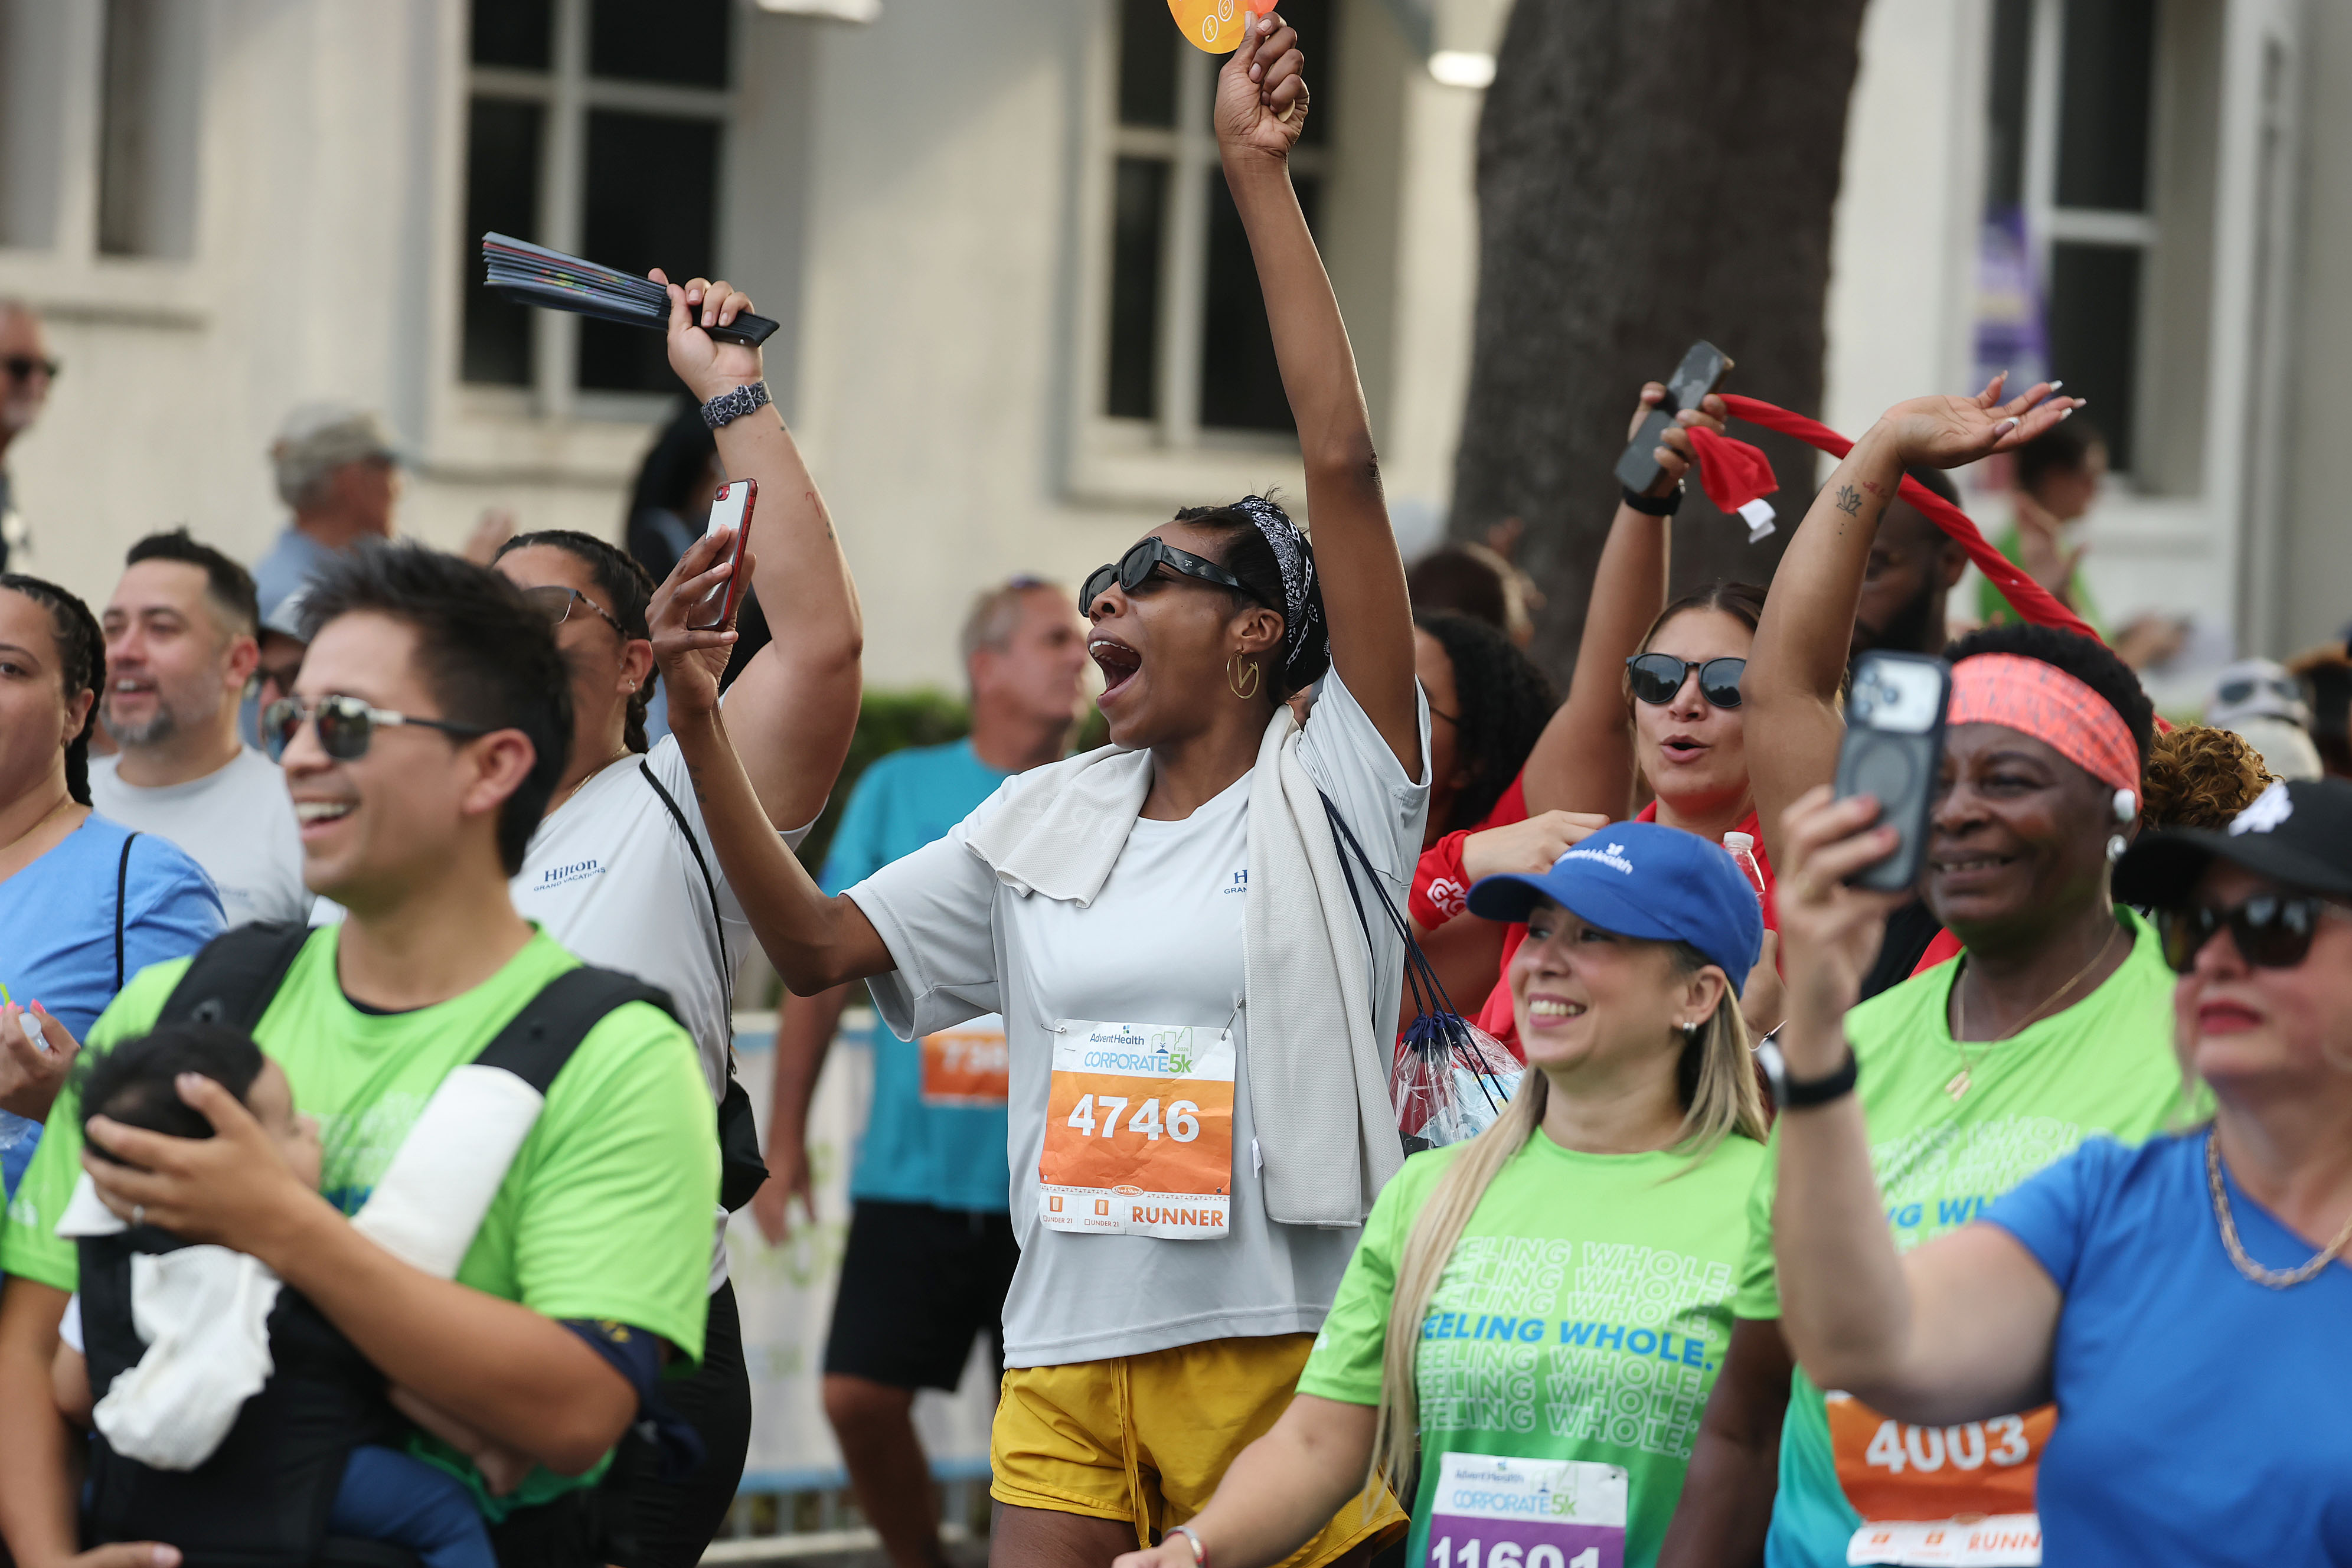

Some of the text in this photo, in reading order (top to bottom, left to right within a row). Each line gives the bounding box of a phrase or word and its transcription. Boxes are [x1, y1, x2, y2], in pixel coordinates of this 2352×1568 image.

[534, 867, 606, 891] GRAND VACATIONS
[544, 859, 597, 882] Hilton
[1224, 886, 1247, 894] GRAN
[1090, 1033, 1144, 1045] AdventHealth
[1067, 1093, 1200, 1143] 4746
[1132, 1206, 1223, 1227] RUNNER
[1455, 1236, 1738, 1297] ELING WHOLE.
[1575, 1266, 1725, 1306] WHOLE
[1422, 1312, 1713, 1372] EELING WHOLE.
[1418, 1340, 1709, 1405] EELING WHOLE.
[1418, 1370, 1700, 1433] EELING WHOLE.
[1544, 1403, 1691, 1461] WHOLE.
[1865, 1413, 2030, 1474] 4003
[1967, 1532, 2041, 1551] RUNN
